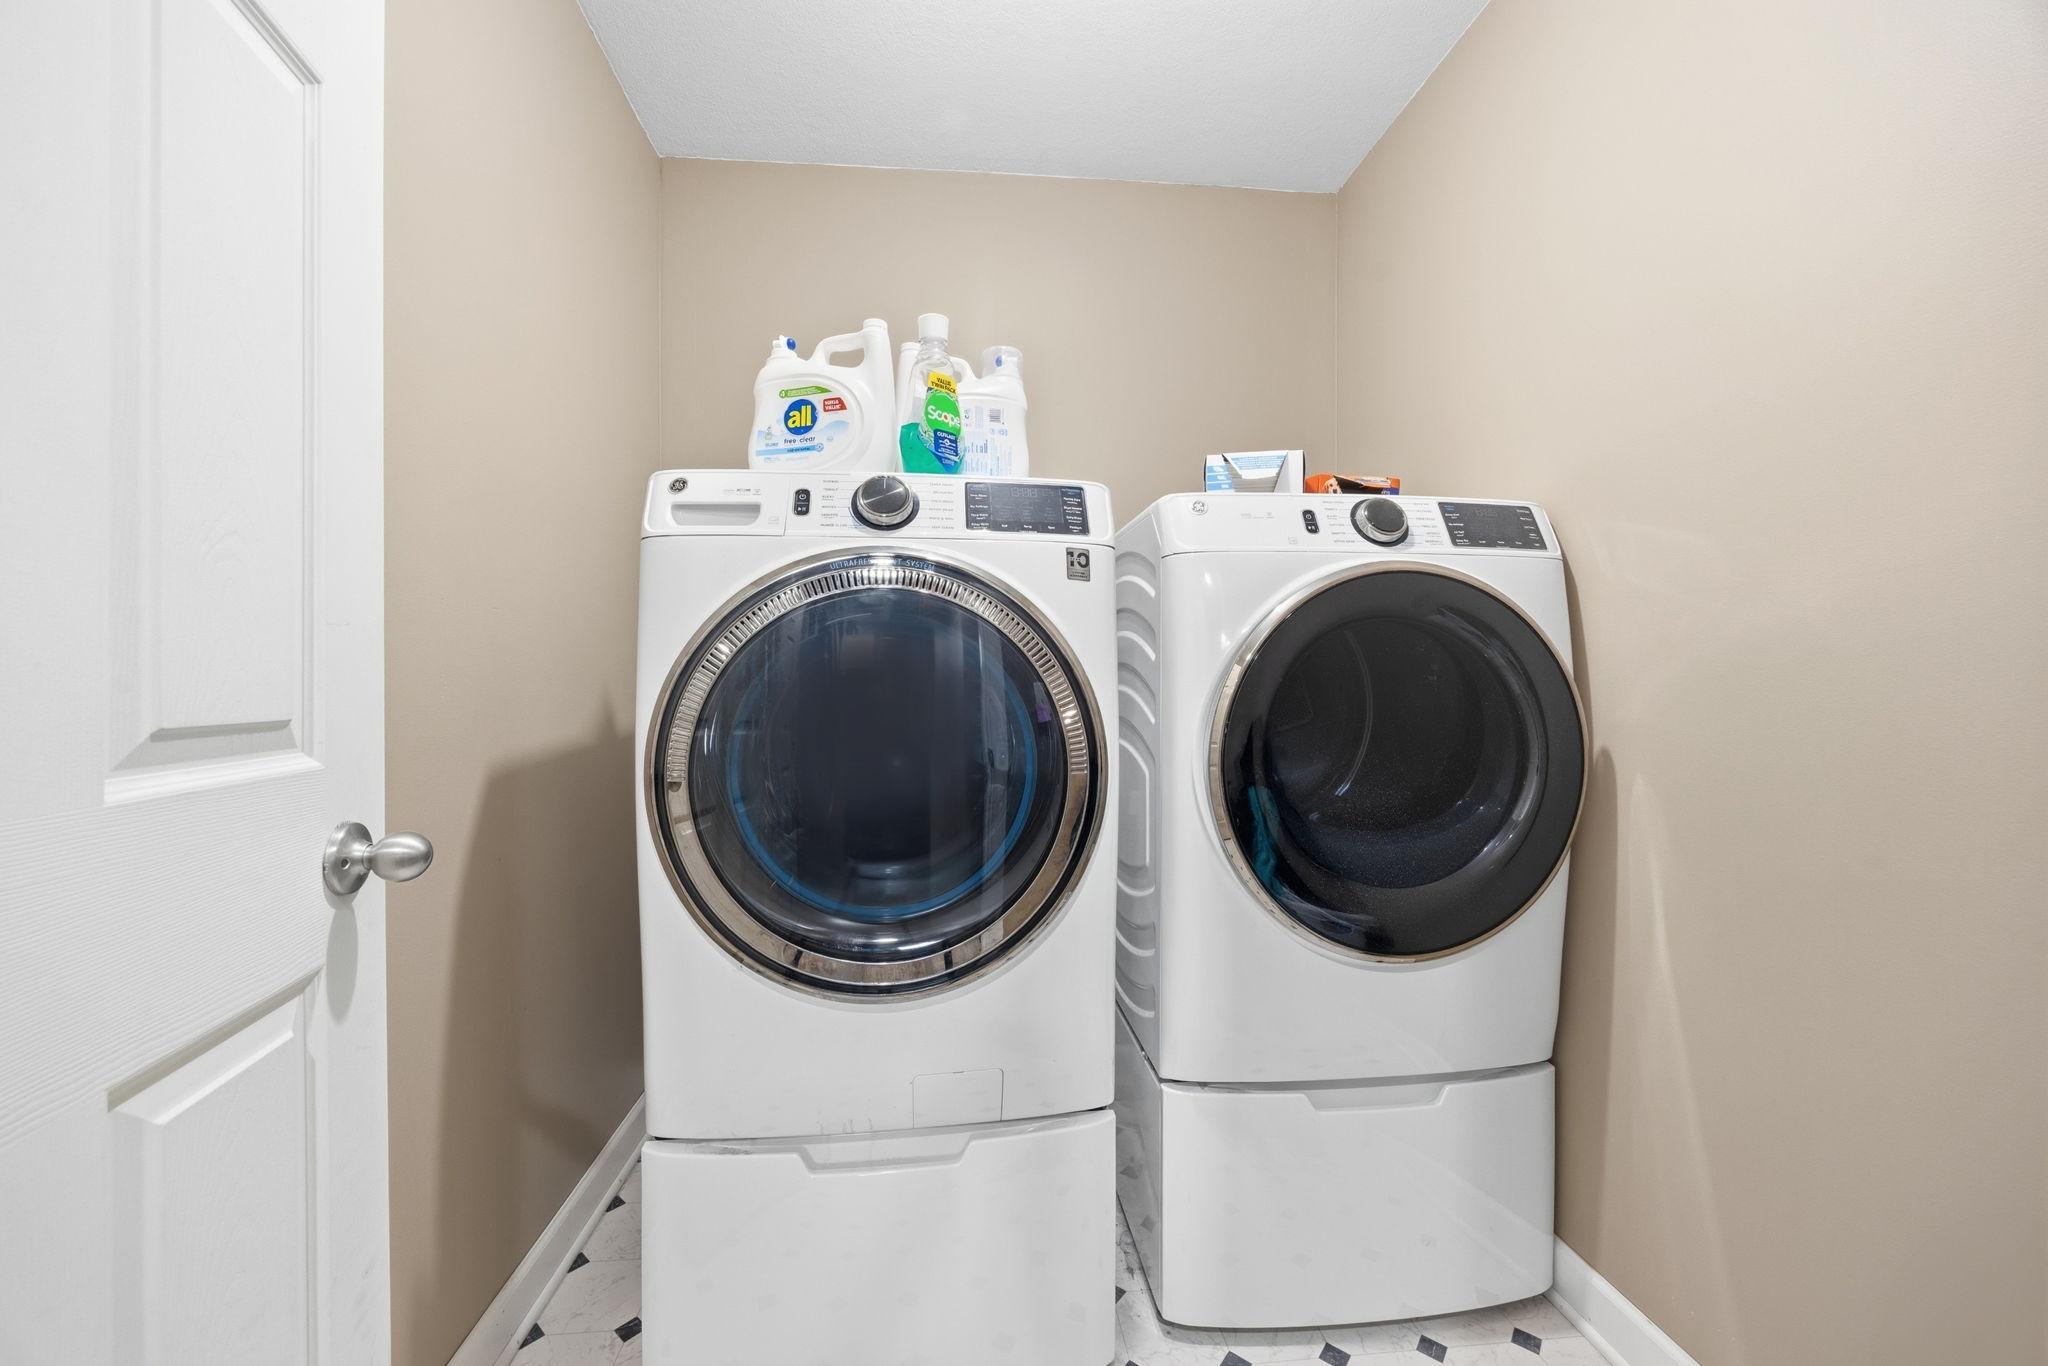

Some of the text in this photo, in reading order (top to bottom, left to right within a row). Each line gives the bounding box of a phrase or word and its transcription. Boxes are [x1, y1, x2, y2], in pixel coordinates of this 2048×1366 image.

[787, 405, 813, 428] all
[927, 405, 961, 428] Scope
[905, 559, 936, 572] SYSTEM
